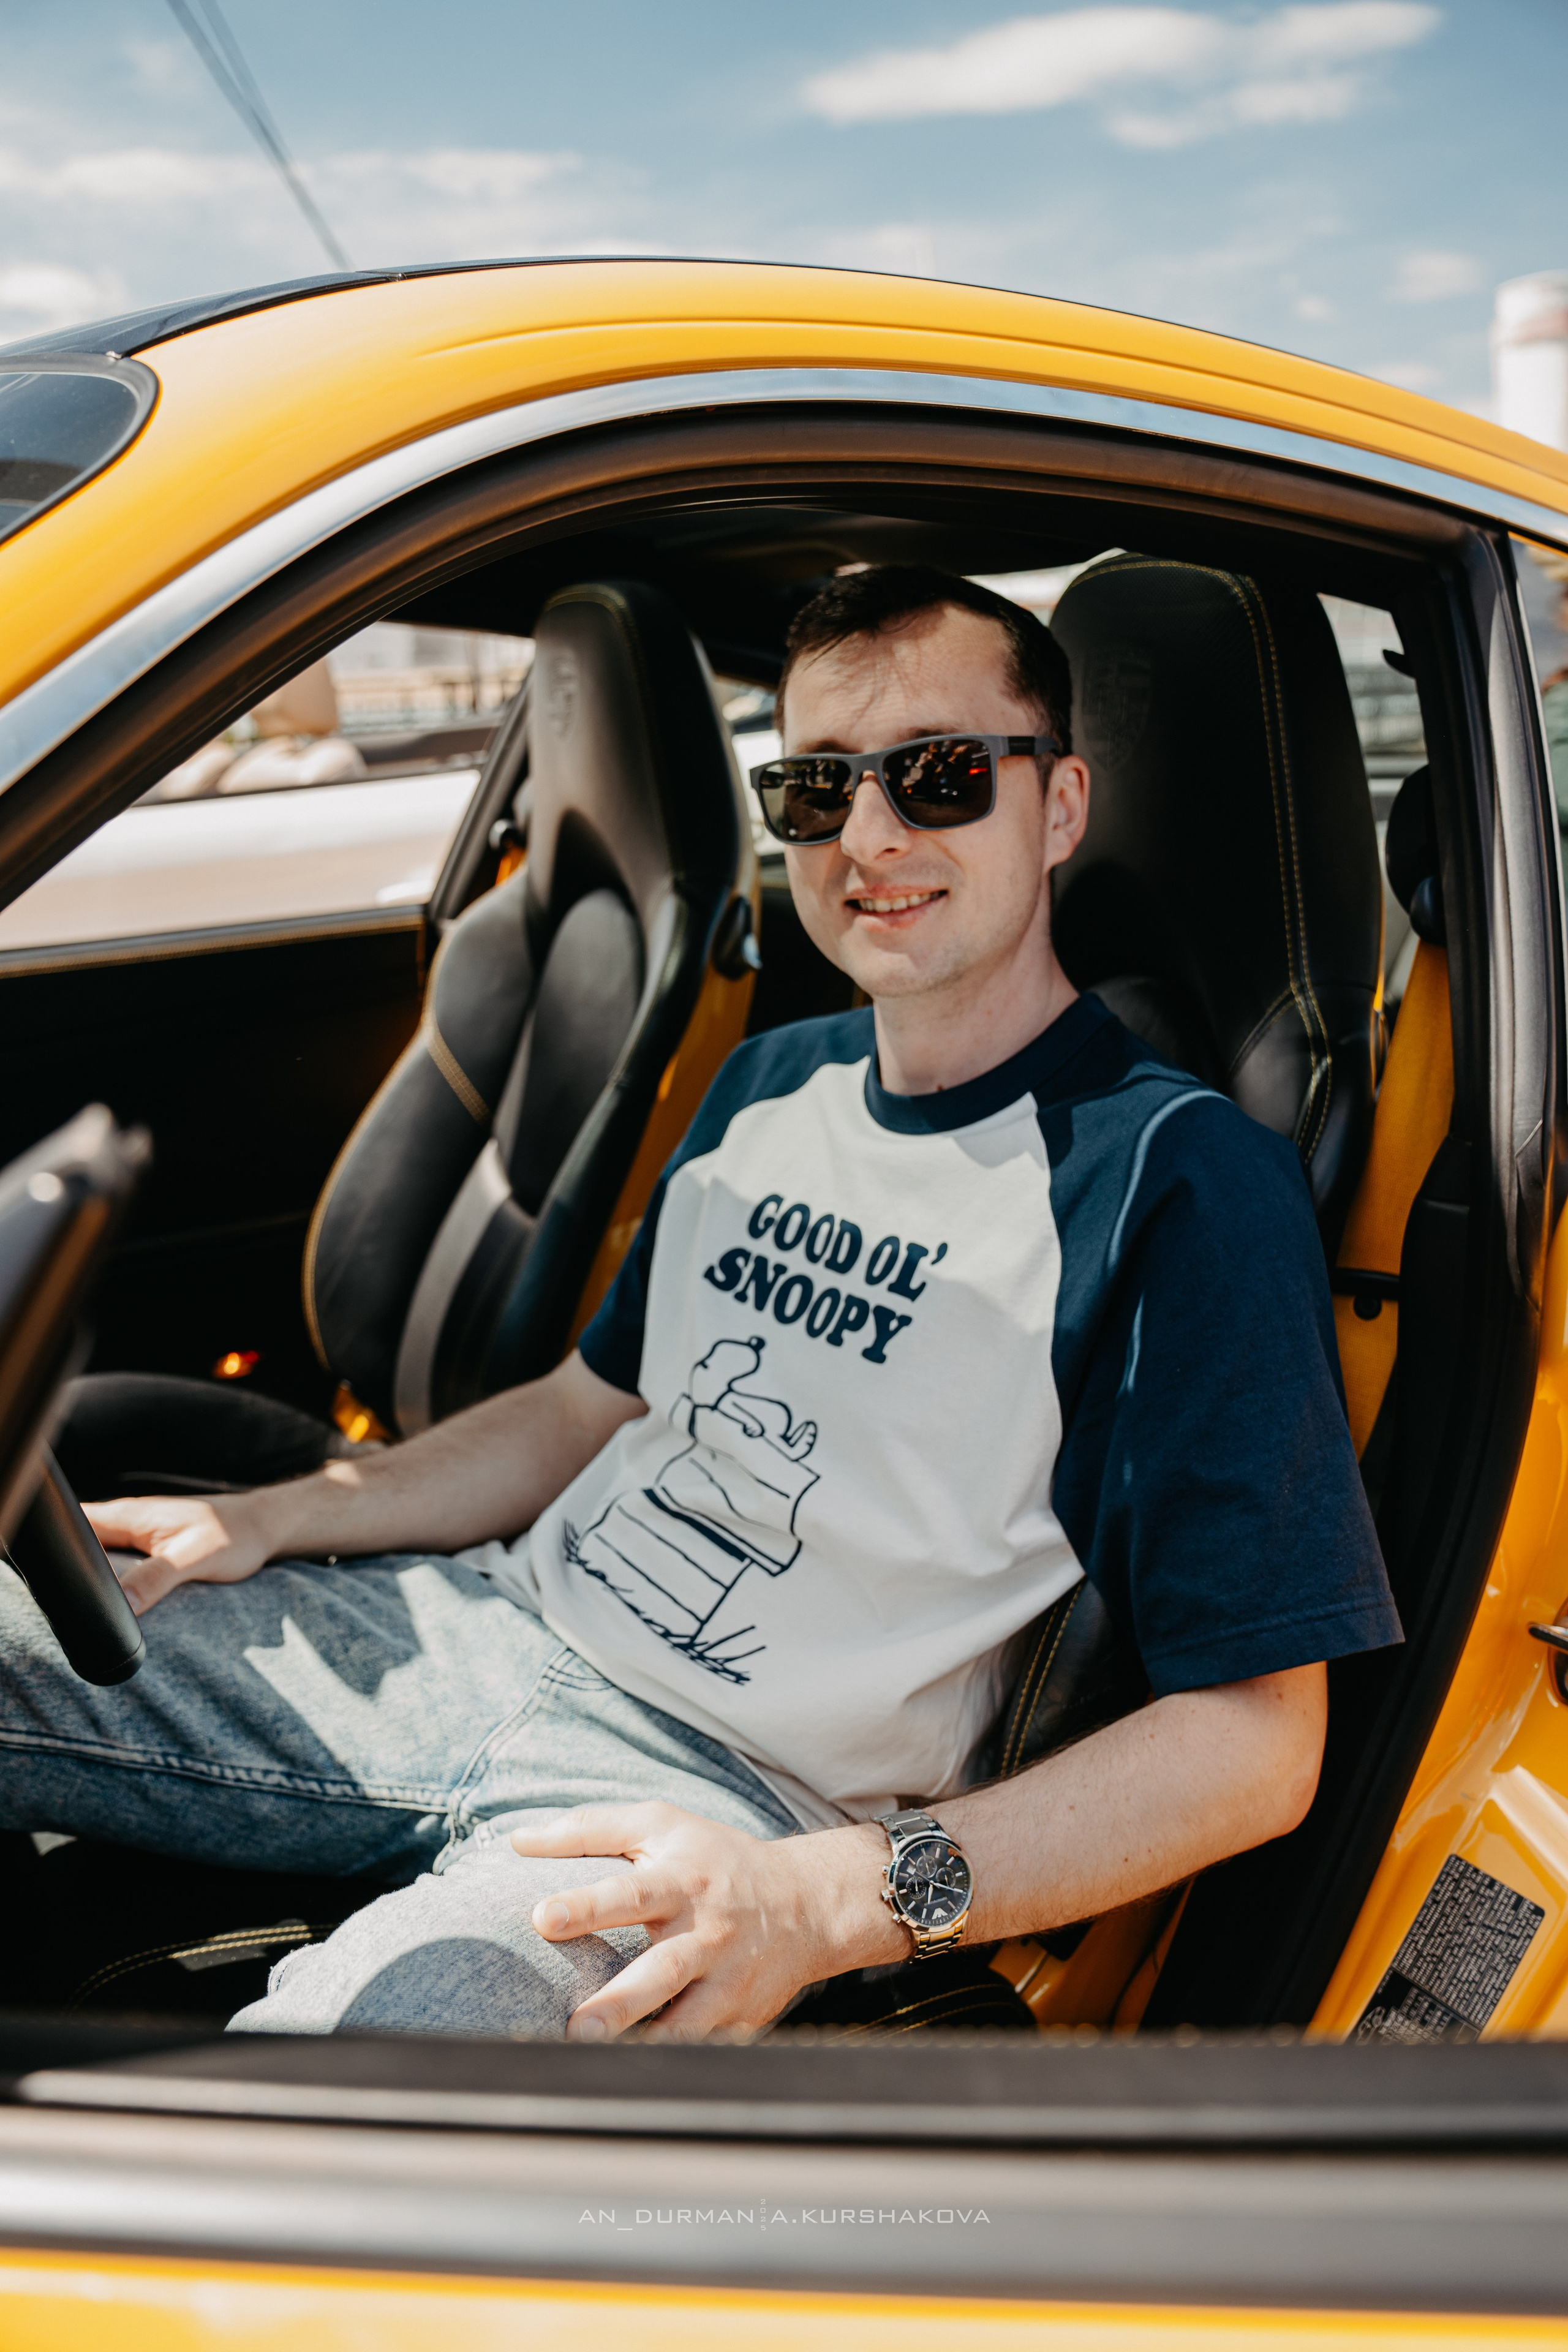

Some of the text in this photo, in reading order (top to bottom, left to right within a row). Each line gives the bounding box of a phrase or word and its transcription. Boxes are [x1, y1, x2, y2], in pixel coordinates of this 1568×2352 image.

[748, 1194, 948, 1302] GOOD OL'
[704, 1247, 913, 1364] SNOOPY
